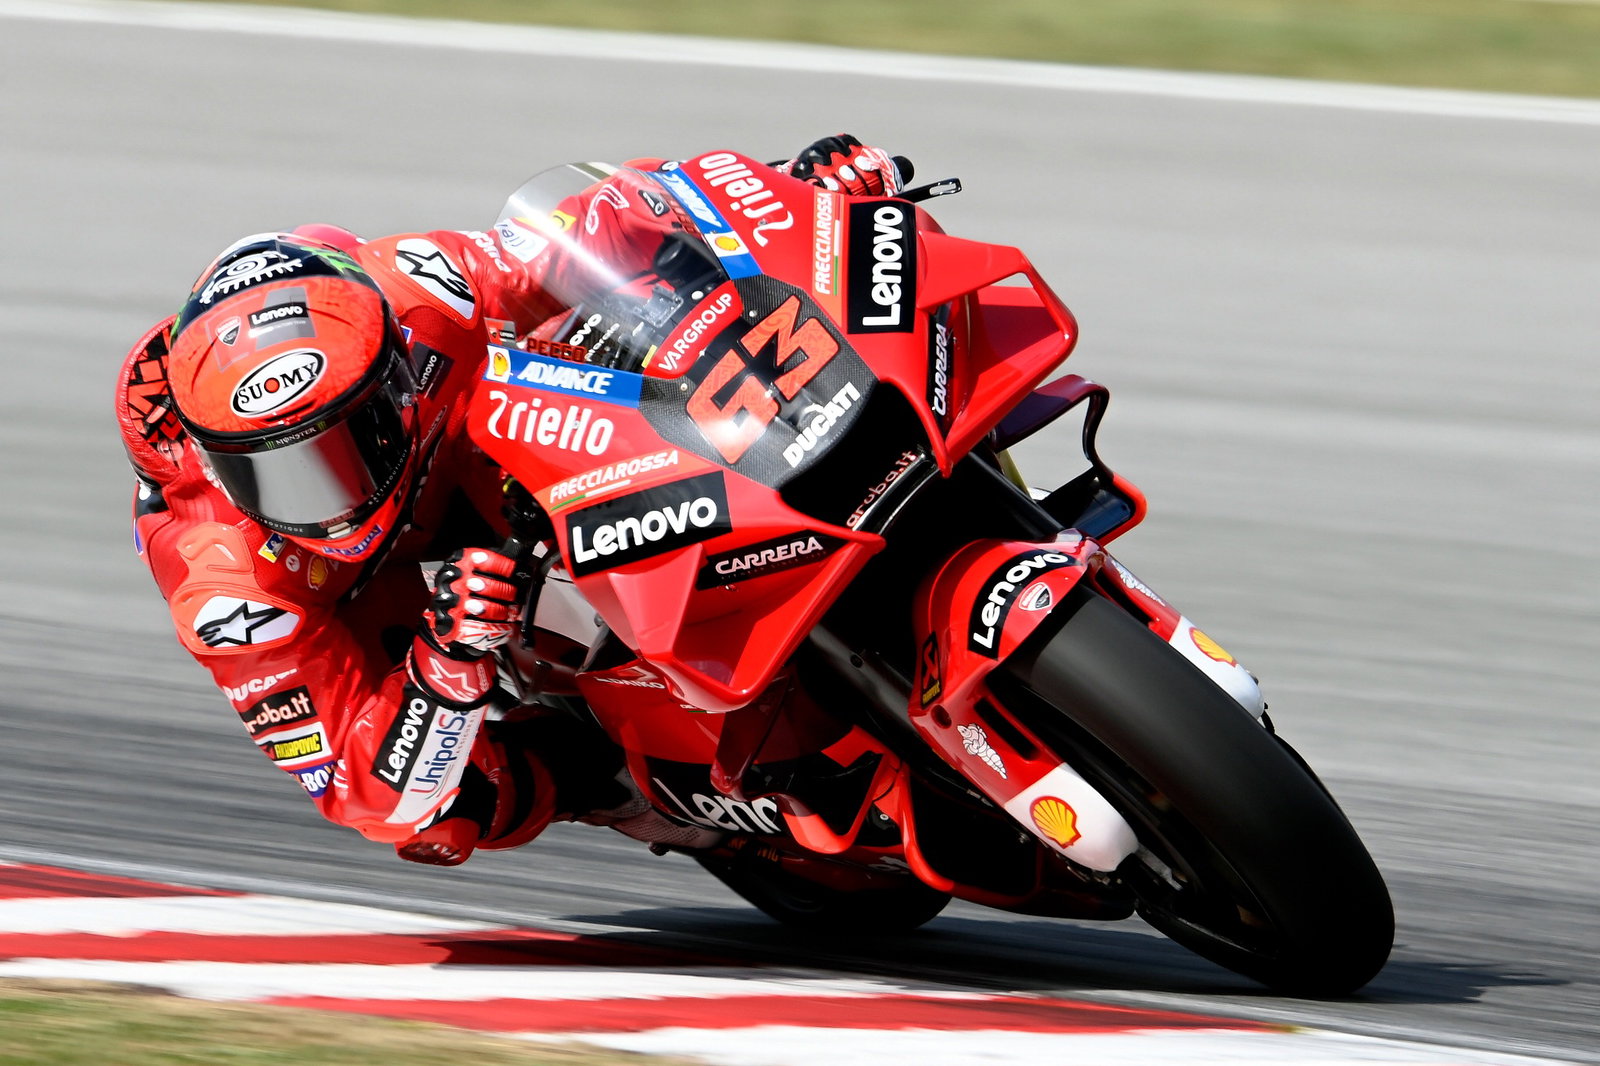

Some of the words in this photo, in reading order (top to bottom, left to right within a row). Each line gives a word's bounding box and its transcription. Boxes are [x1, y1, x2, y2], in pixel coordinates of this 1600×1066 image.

[815, 192, 833, 295] FRECCIAROSSA
[862, 206, 905, 327] Lenovo
[251, 305, 303, 325] Lenovo
[569, 313, 602, 346] ovo
[658, 293, 733, 372] VARGROUP
[237, 361, 319, 404] SUOMY
[415, 354, 438, 391] Lenovo
[516, 361, 614, 395] ADVANCE
[933, 322, 948, 416] CARRERA
[782, 381, 861, 468] DUCATI
[550, 449, 679, 503] FRECCIAROSSA
[571, 497, 718, 564] Lenovo
[715, 536, 824, 575] CARRERA
[972, 551, 1069, 650] Lenovo
[242, 692, 310, 734] ruba.it
[378, 697, 428, 784] Lenovo
[409, 708, 470, 793] UnipolS
